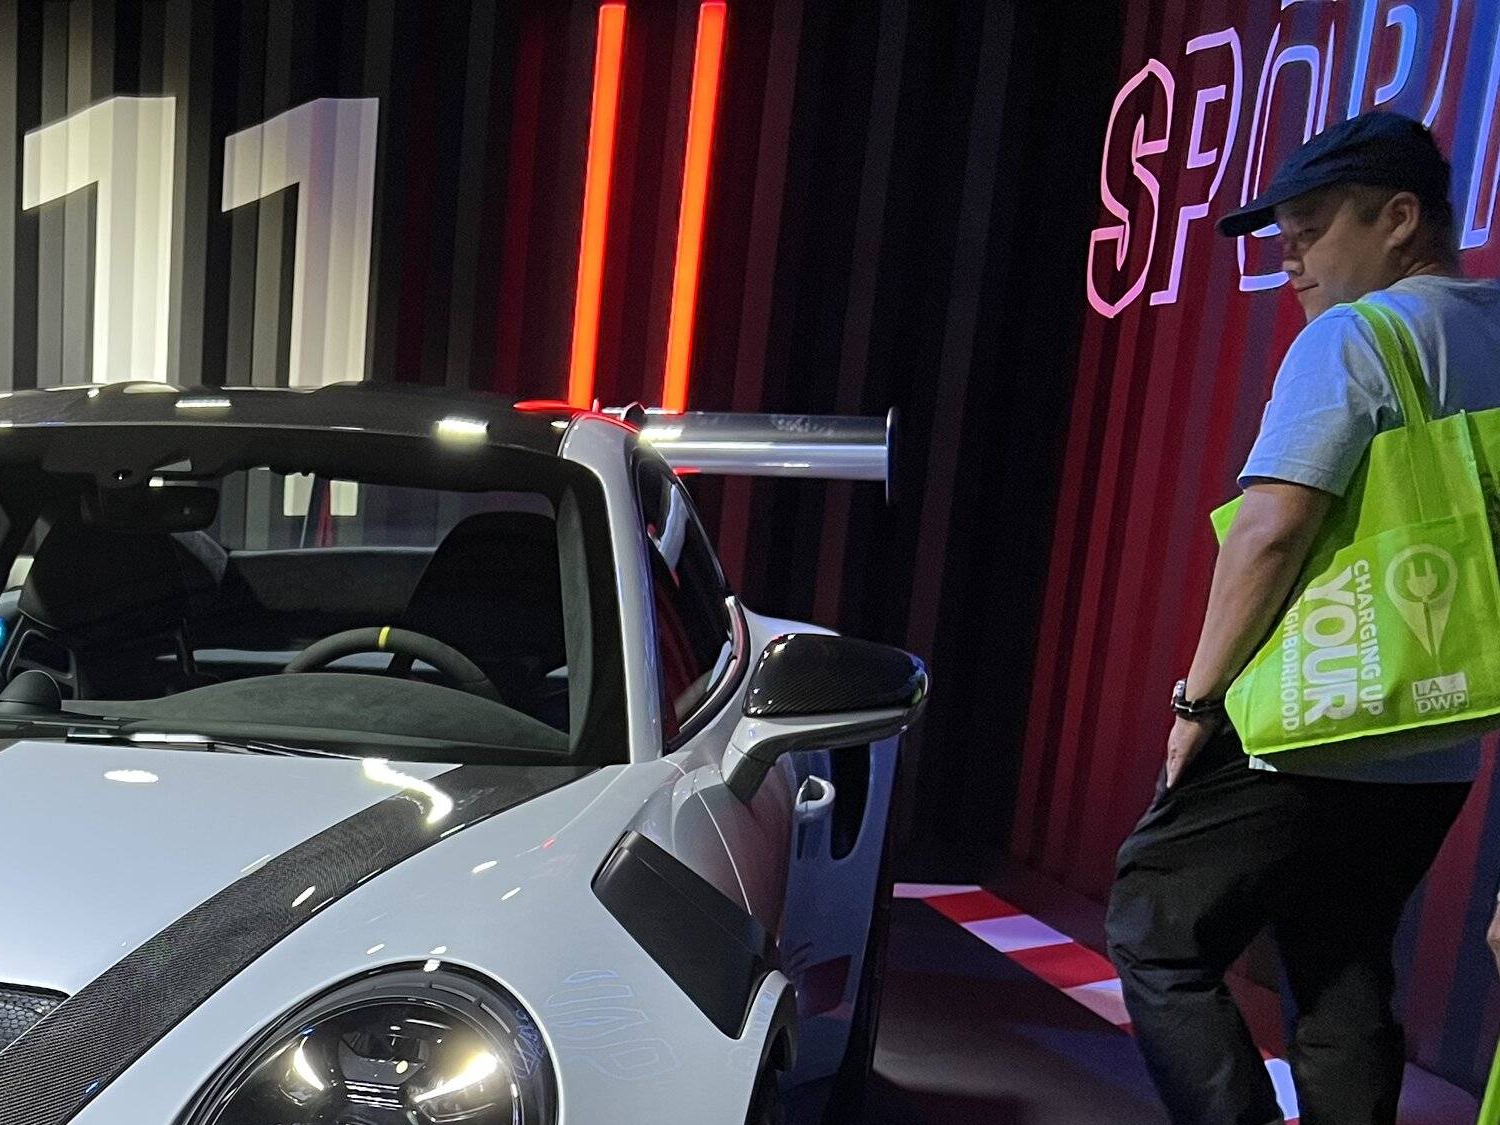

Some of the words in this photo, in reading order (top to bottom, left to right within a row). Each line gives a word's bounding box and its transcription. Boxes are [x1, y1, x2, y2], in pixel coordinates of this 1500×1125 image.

[1302, 565, 1358, 726] YOUR
[1353, 559, 1382, 681] CHARGING
[1281, 598, 1301, 731] IGHBORHOOD
[1362, 684, 1384, 715] UP
[1415, 679, 1441, 697] LA
[1417, 694, 1466, 714] DWP
